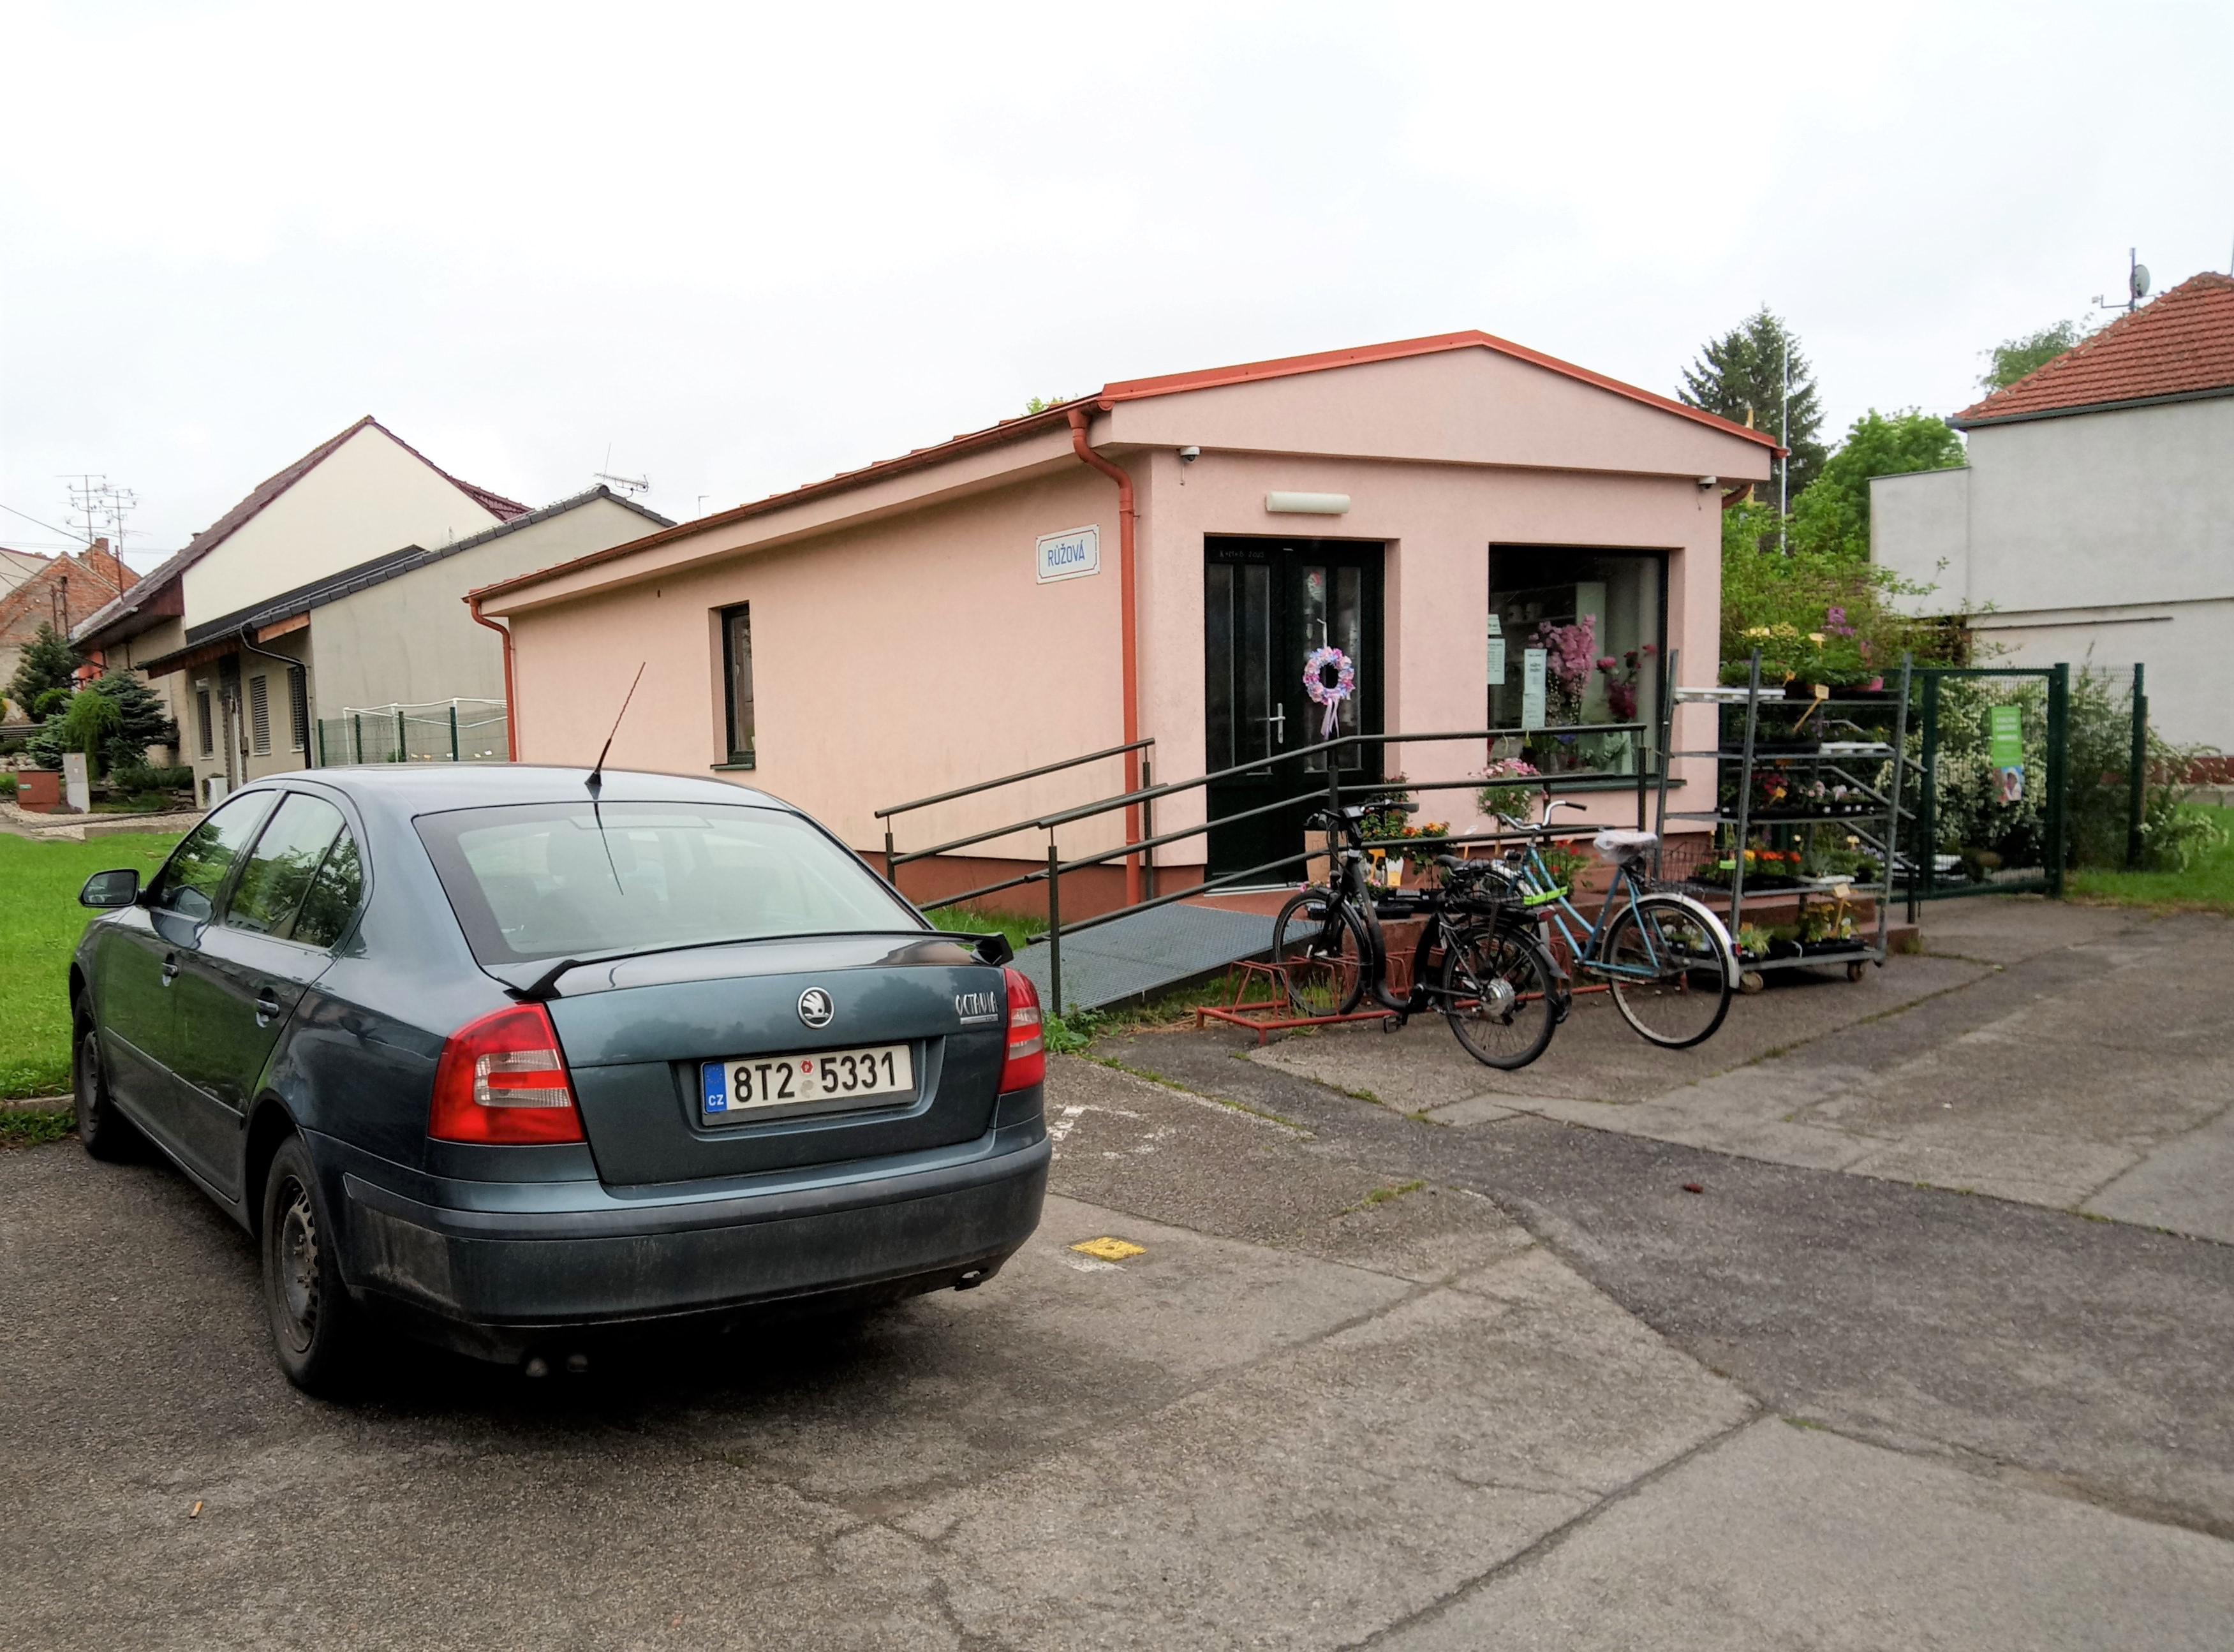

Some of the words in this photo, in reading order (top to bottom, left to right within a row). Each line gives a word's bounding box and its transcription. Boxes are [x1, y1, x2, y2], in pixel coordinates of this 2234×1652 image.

[1048, 539, 1085, 566] RŮŽOVÁ
[956, 991, 998, 1015] OCTAVIA
[734, 1062, 795, 1103] 8T2
[820, 1051, 896, 1093] 5331
[708, 1094, 724, 1106] CZ
